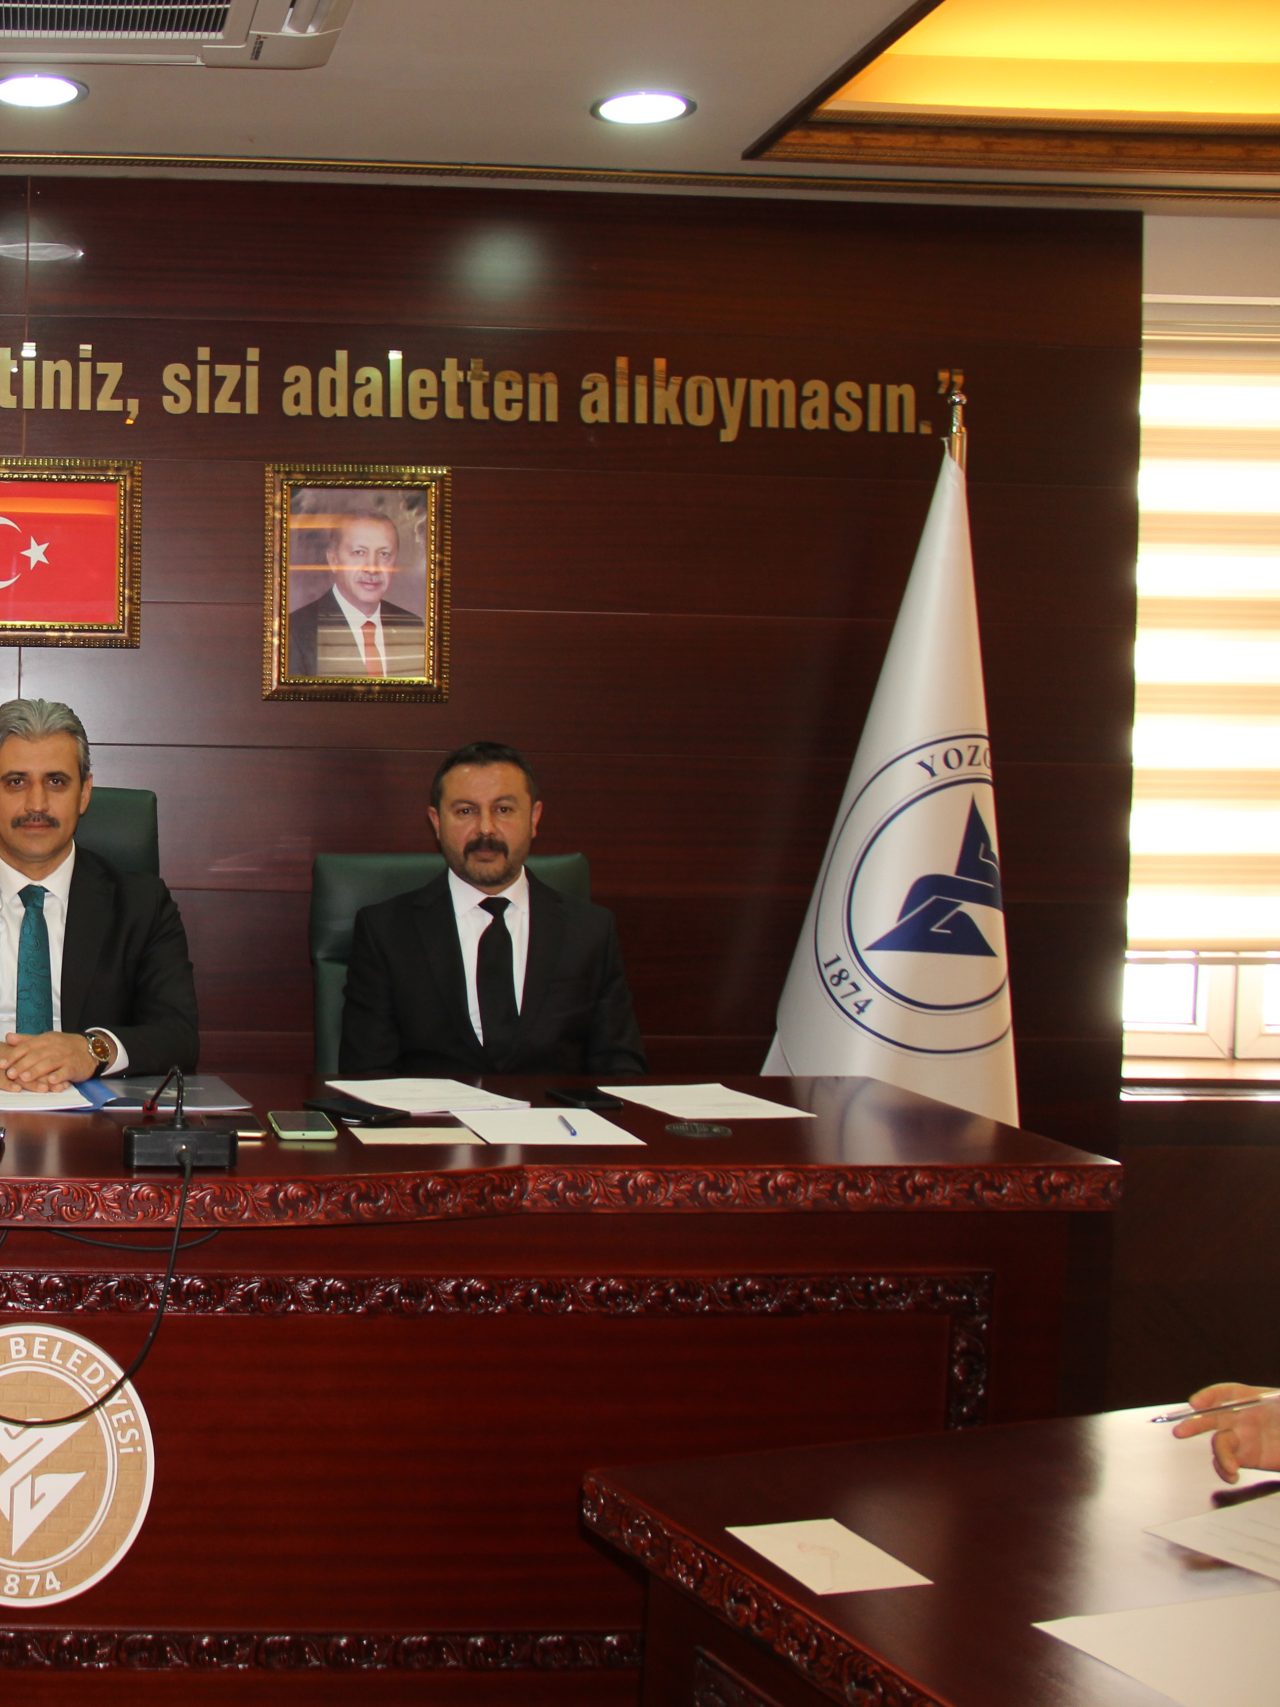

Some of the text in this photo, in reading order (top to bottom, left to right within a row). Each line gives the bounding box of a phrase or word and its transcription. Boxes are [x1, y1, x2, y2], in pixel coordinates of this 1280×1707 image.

[162, 346, 260, 415] sizi
[282, 350, 559, 422] adaletten
[822, 953, 874, 1016] 1874
